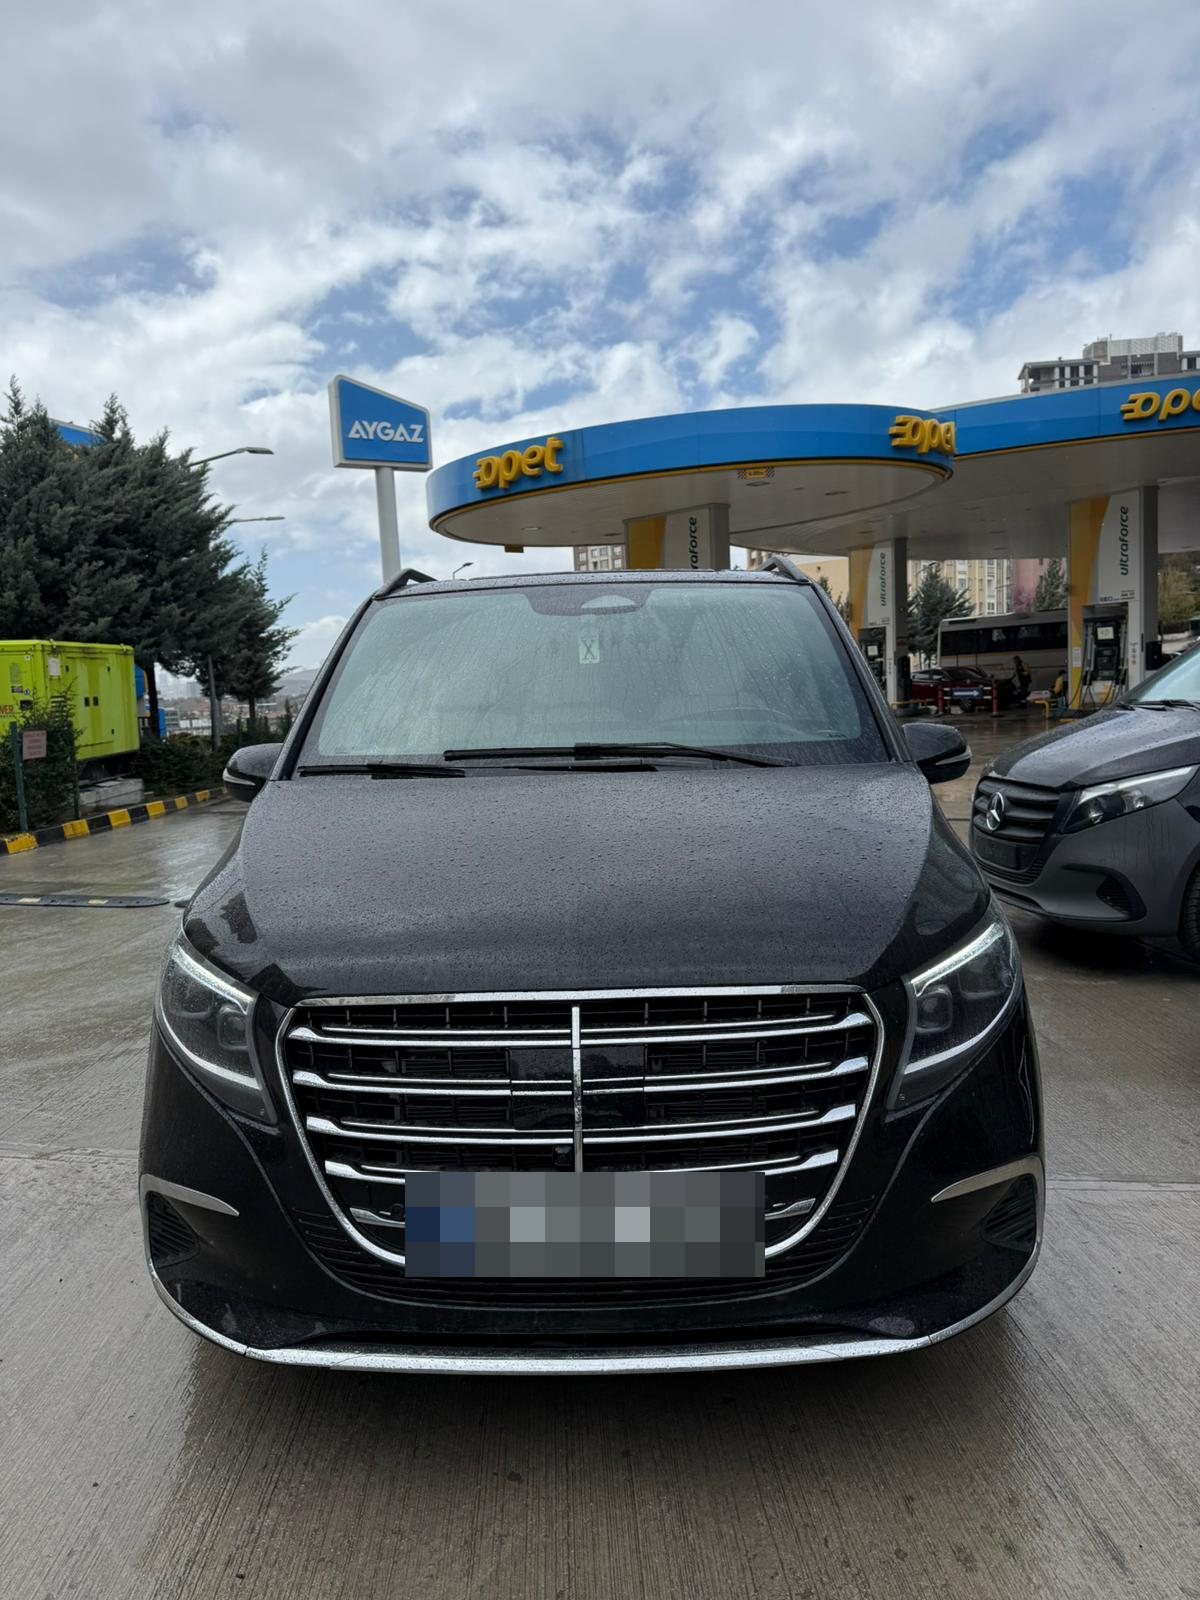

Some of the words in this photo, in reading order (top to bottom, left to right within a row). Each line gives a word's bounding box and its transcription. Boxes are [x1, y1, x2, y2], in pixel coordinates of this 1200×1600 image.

[348, 420, 424, 443] AYGAZ
[888, 414, 956, 454] ope
[472, 437, 564, 489] opet
[688, 516, 698, 569] raforce
[1119, 505, 1129, 576] ultraforce
